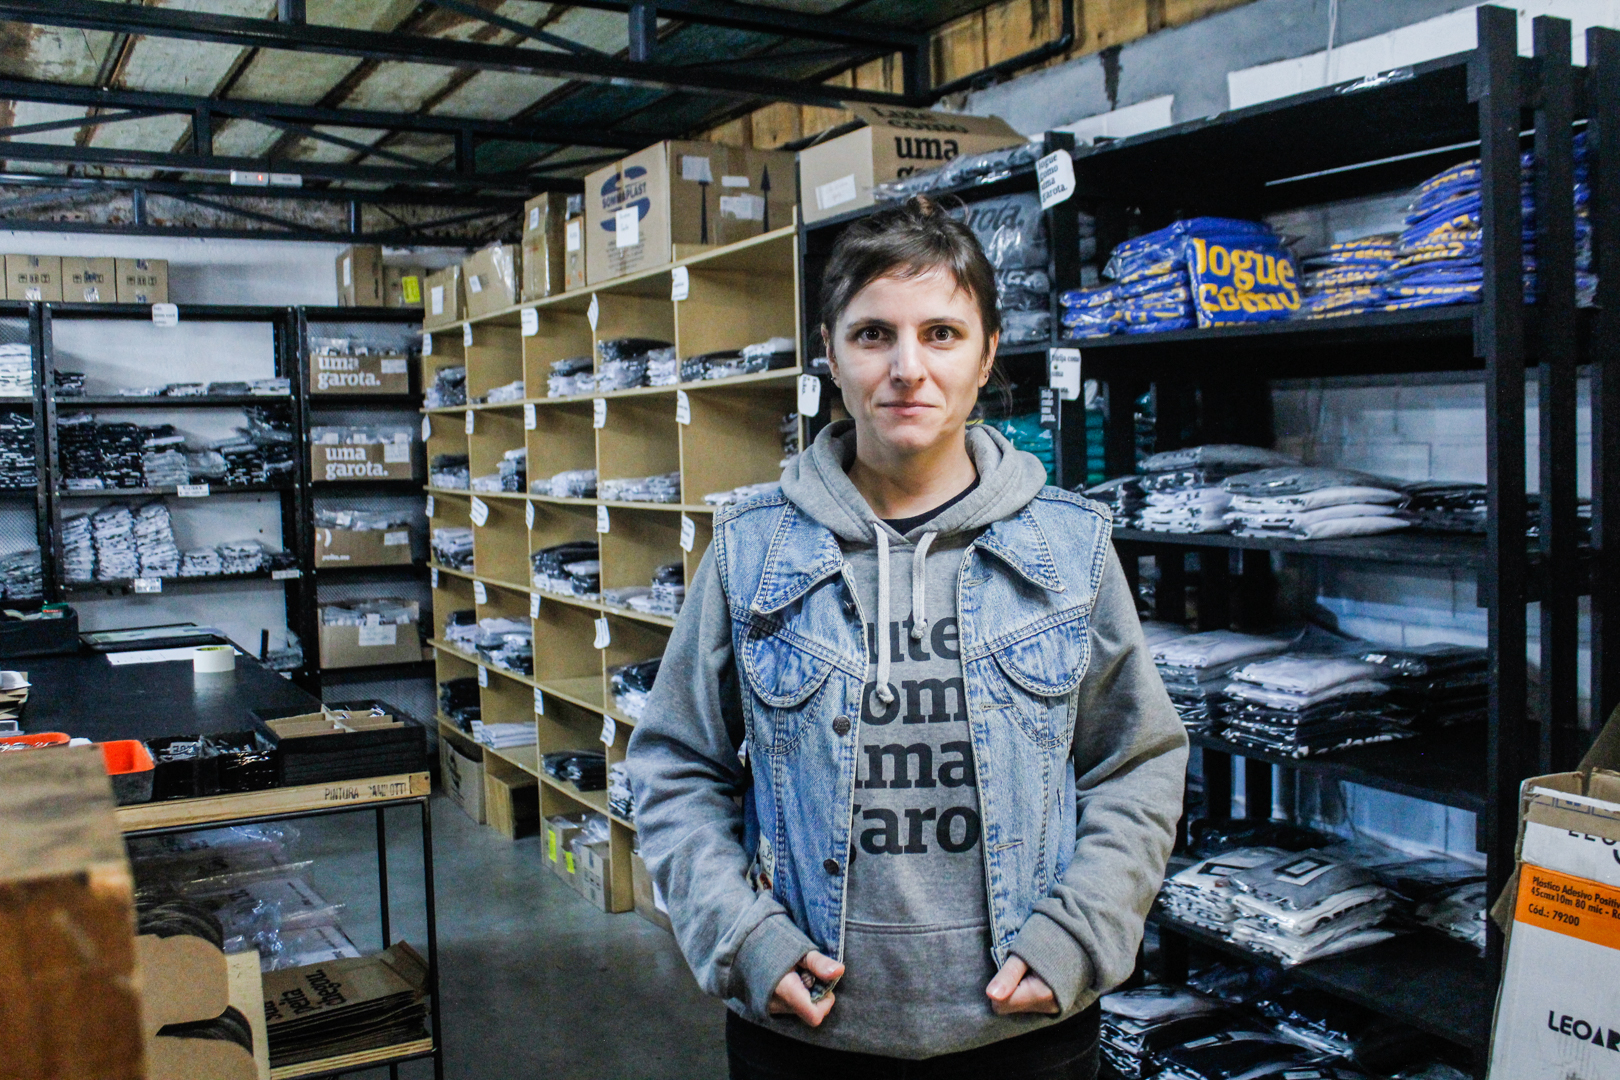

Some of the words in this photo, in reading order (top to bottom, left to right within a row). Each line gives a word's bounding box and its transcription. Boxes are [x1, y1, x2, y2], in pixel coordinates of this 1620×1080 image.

[895, 136, 959, 161] uma
[1193, 238, 1297, 291] Jogue
[318, 356, 359, 371] uma
[318, 371, 381, 390] garota.
[325, 447, 367, 461] uma
[325, 461, 389, 480] garota.
[868, 610, 961, 665] ute
[861, 676, 969, 726] om
[854, 740, 977, 789] ma
[850, 804, 981, 864] aro
[1532, 876, 1561, 892] Plástico
[1562, 884, 1593, 901] Adesivo
[1552, 910, 1580, 927] 79200
[1575, 897, 1586, 910] 80
[1587, 904, 1603, 916] mic
